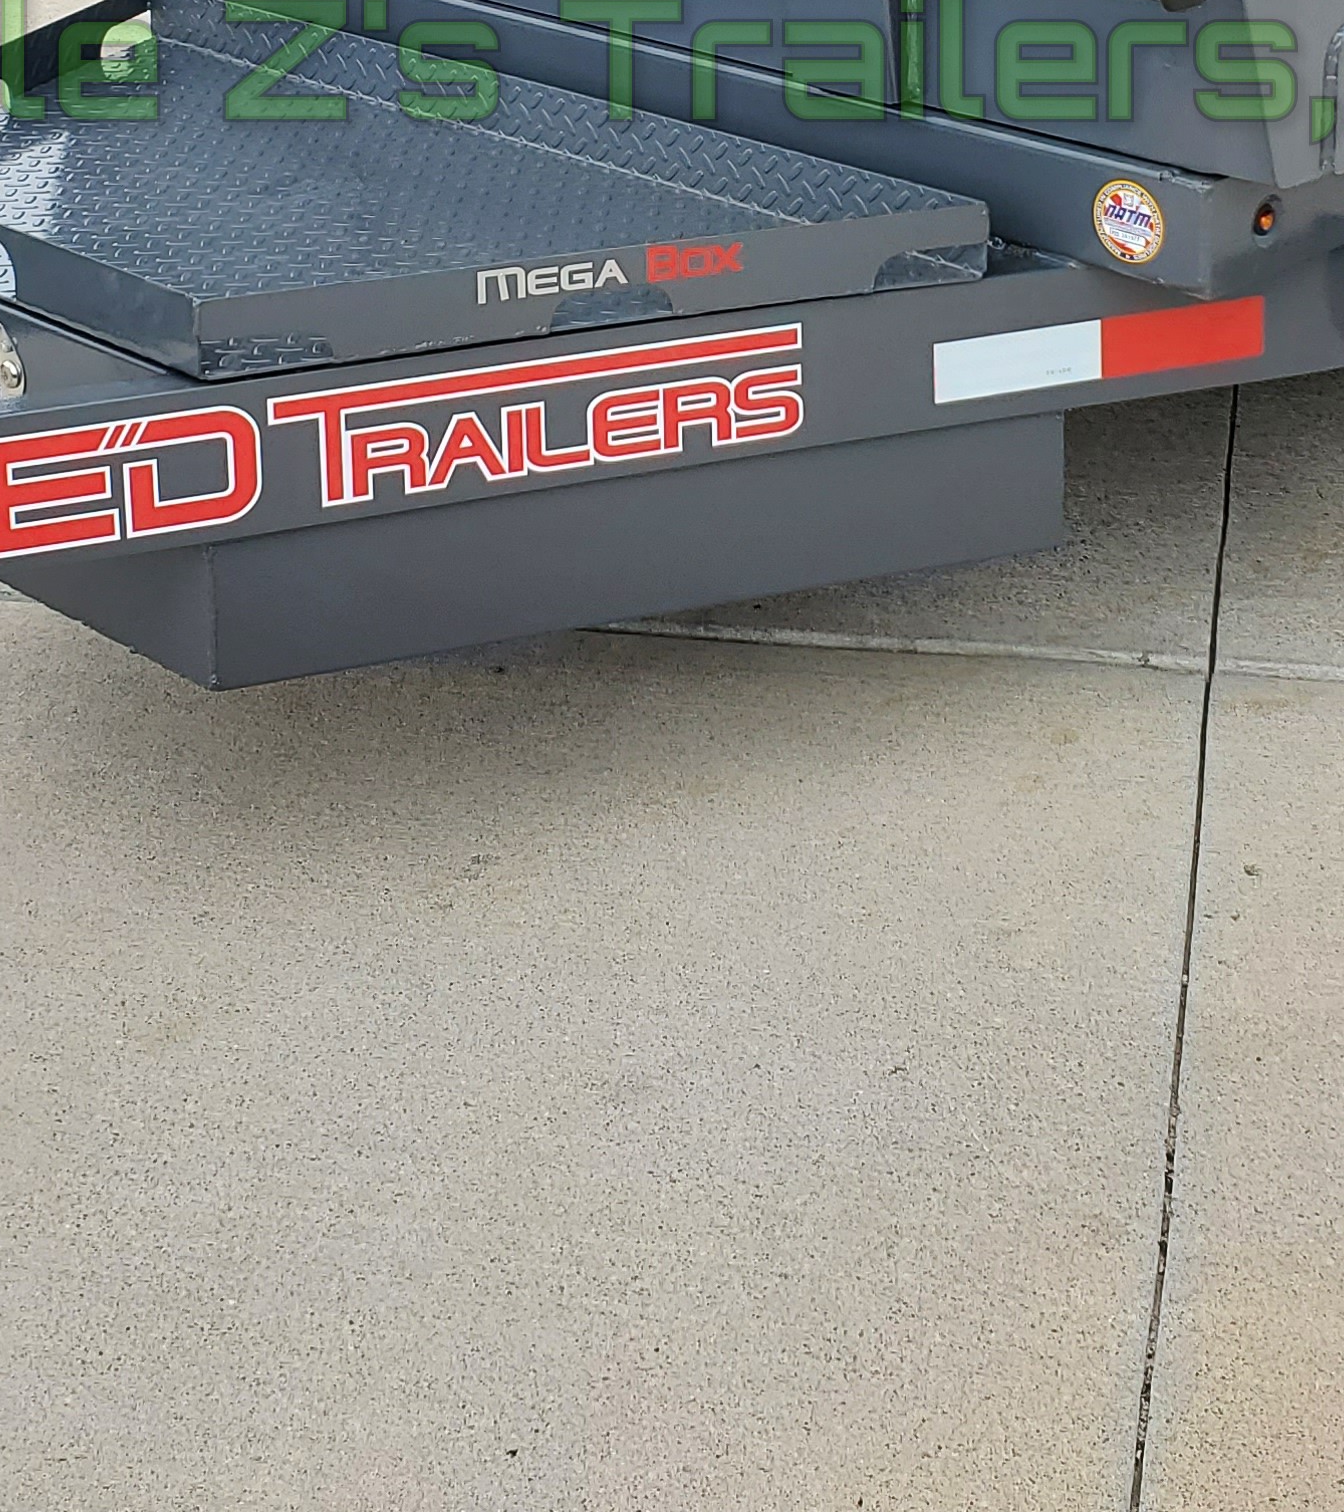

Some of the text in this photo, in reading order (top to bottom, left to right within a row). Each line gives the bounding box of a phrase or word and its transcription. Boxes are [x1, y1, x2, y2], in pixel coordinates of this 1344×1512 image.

[1104, 204, 1153, 228] NATM
[476, 241, 744, 305] MEGA BOX
[267, 322, 804, 509] TRAILERS
